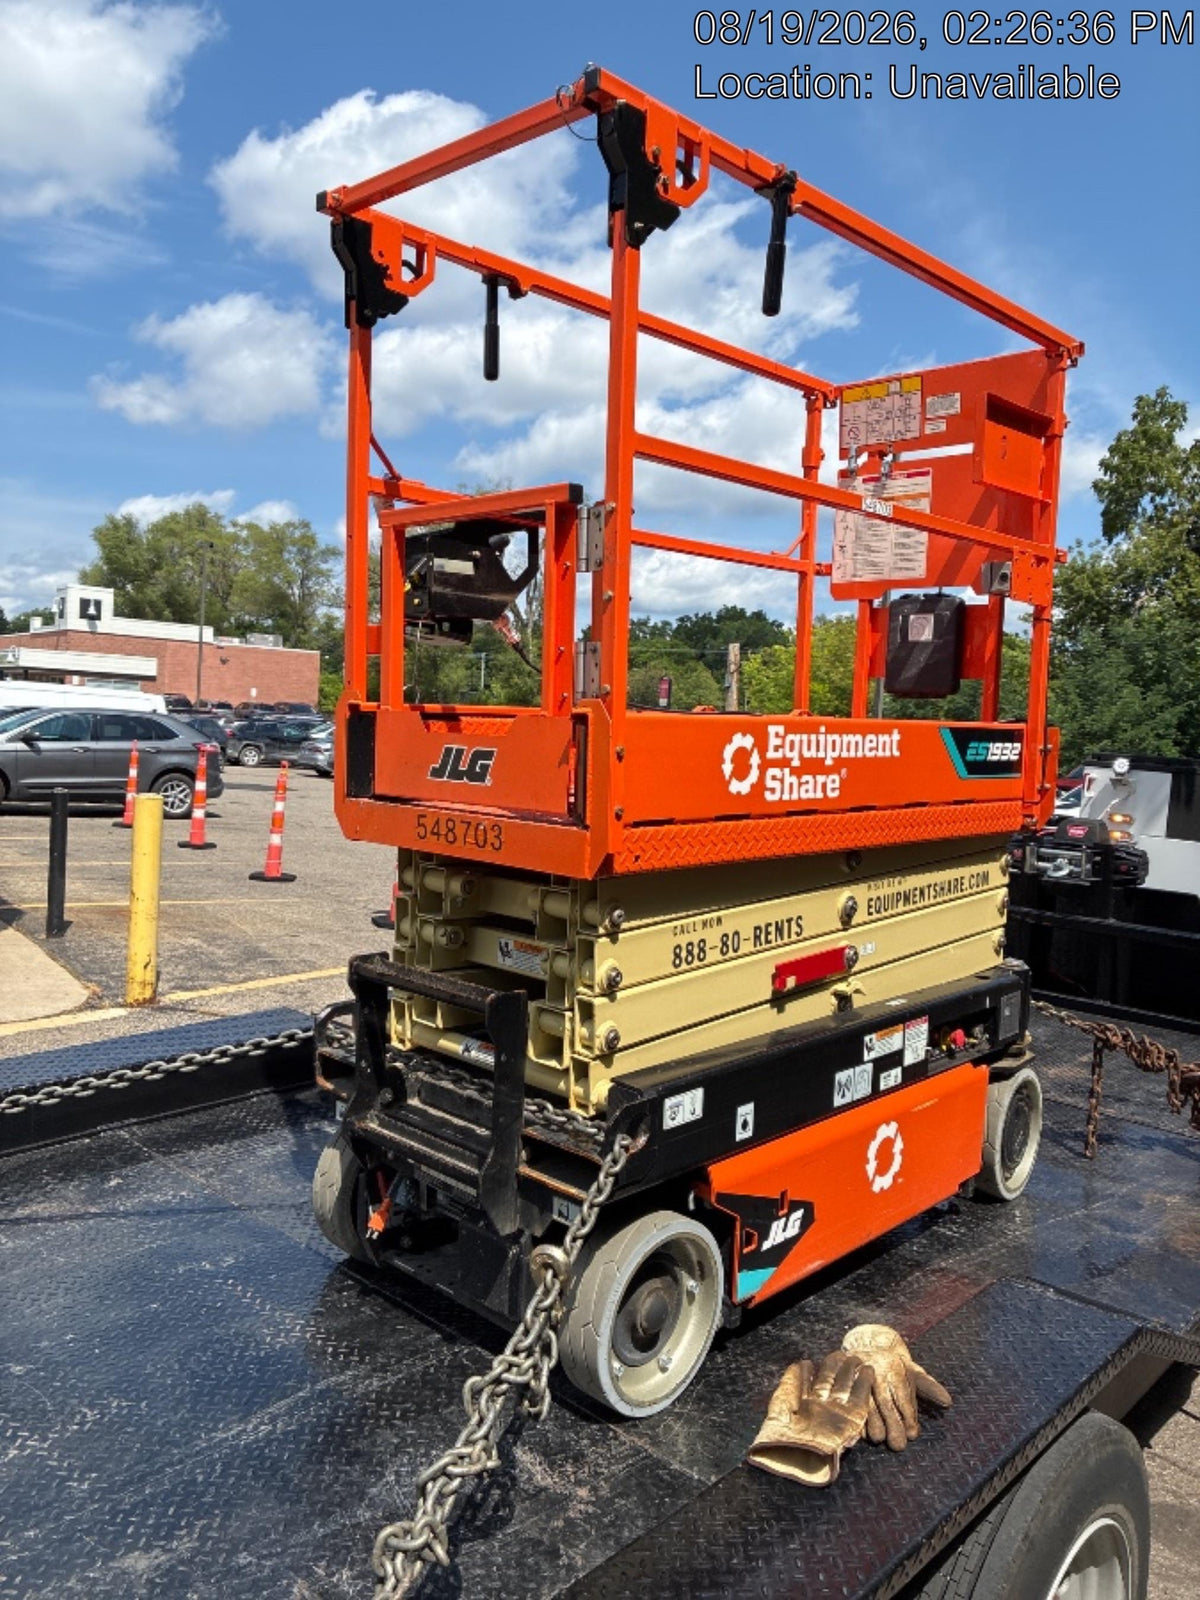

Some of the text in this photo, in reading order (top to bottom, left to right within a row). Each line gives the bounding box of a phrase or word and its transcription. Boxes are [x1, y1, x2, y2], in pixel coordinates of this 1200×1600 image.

[427, 744, 497, 786] JLG
[766, 725, 901, 767] Equipment
[966, 741, 1022, 762] ES1932
[416, 813, 502, 851] 548703
[867, 870, 990, 917] EQUIPMENTSHARE.COM
[672, 915, 804, 970] 888-80-RENTS
[761, 1208, 804, 1252] JLG
